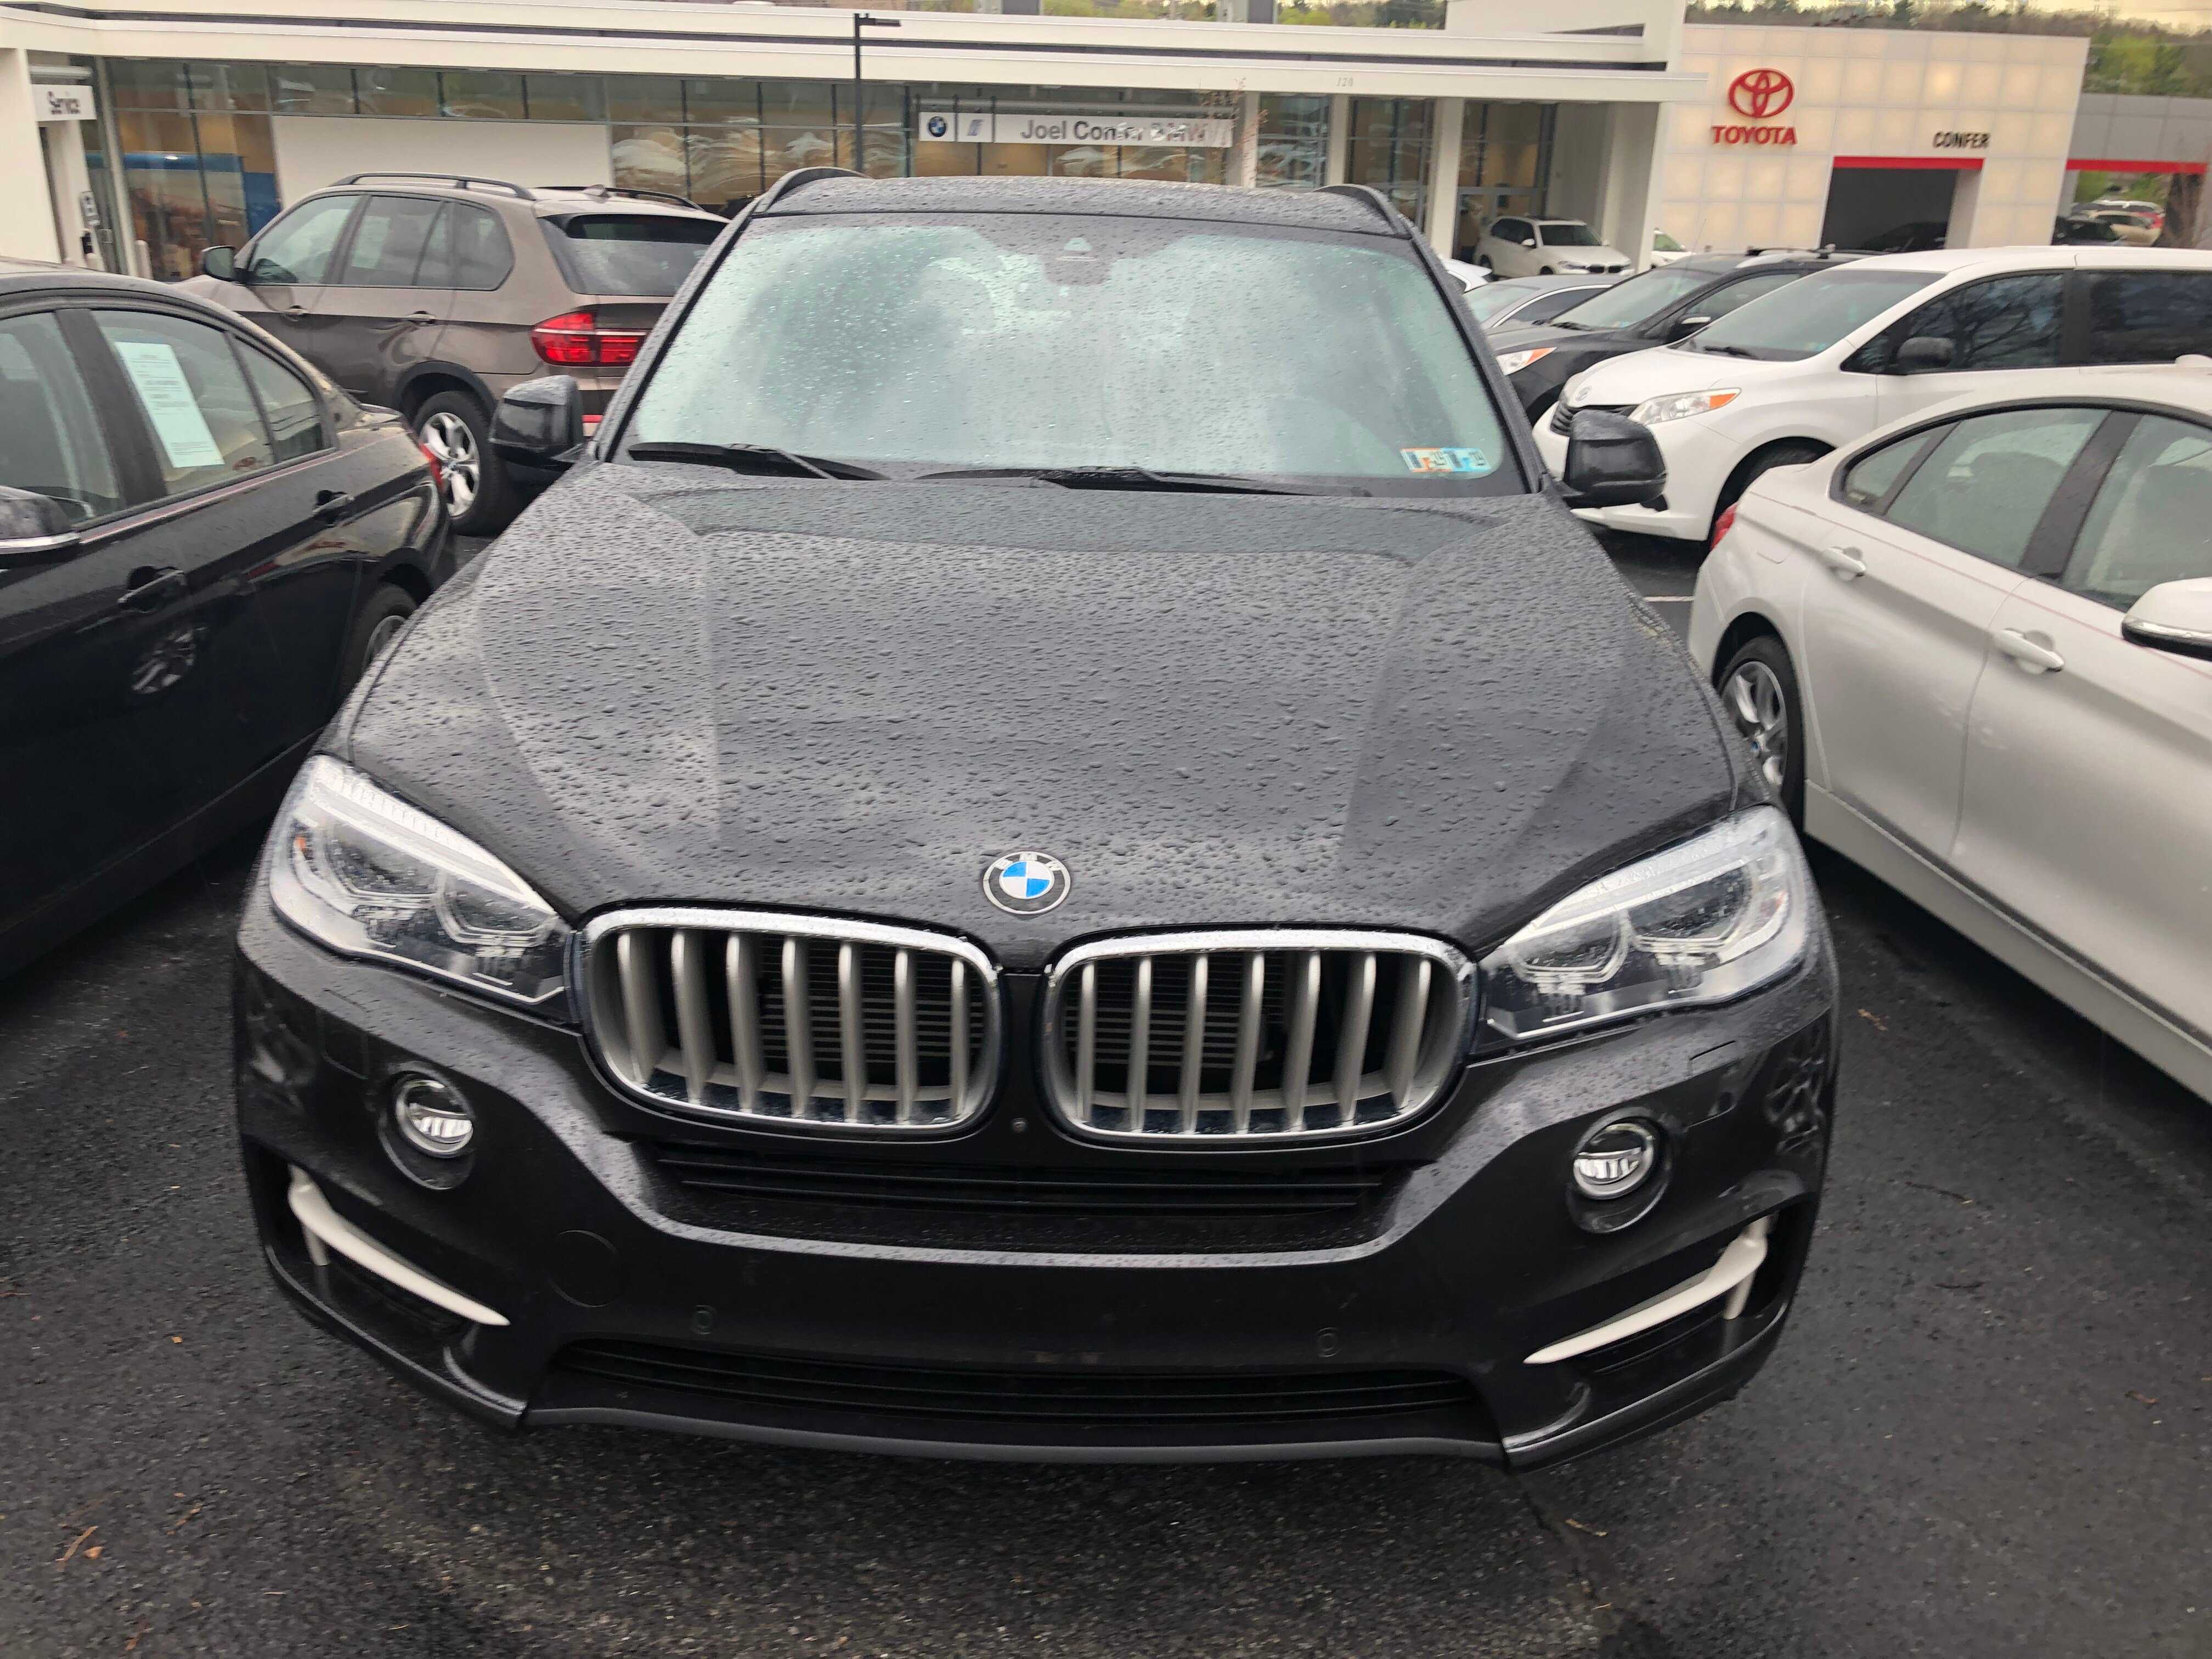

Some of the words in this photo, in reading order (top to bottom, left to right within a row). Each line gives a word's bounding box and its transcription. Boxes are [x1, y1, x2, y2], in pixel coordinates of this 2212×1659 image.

[1020, 120, 1067, 140] Joel
[1711, 125, 1797, 146] TOYOTA
[1932, 131, 1991, 149] CONFER
